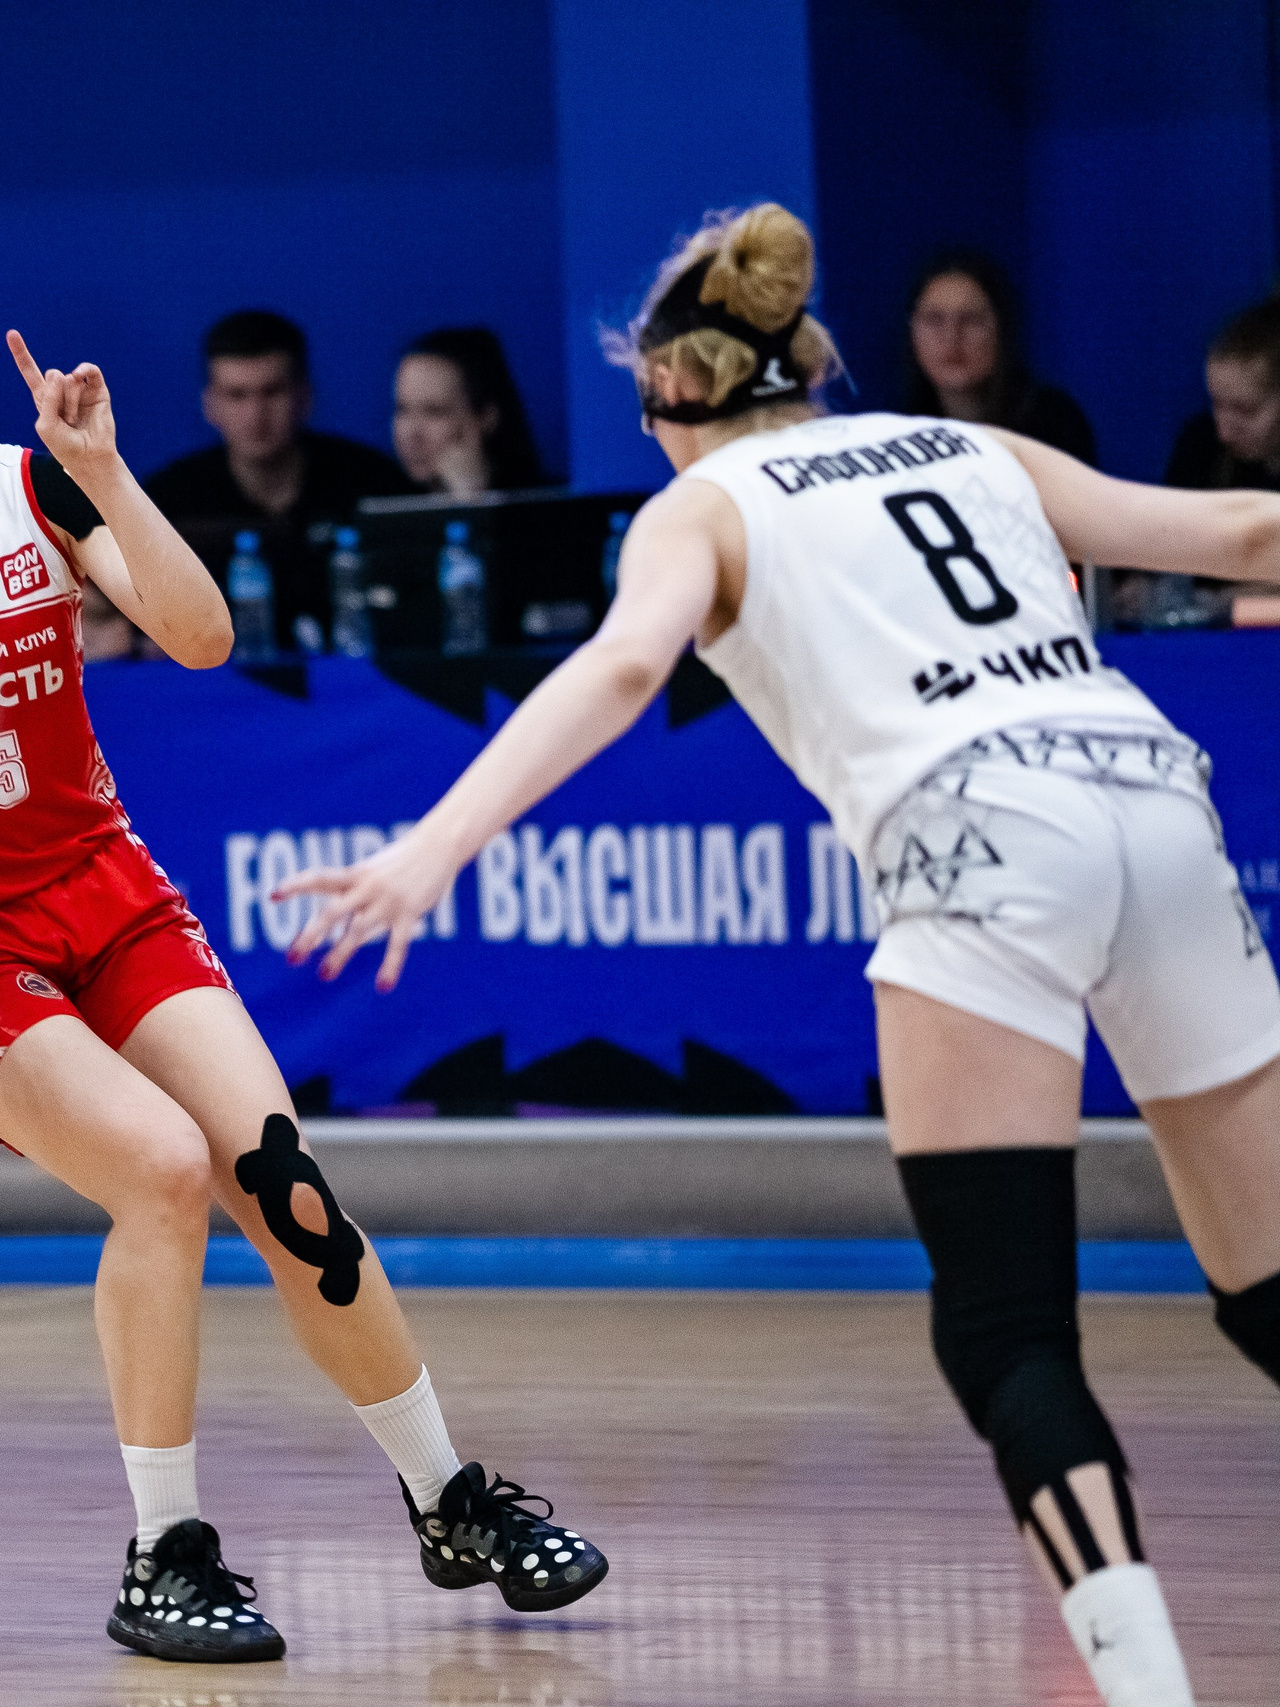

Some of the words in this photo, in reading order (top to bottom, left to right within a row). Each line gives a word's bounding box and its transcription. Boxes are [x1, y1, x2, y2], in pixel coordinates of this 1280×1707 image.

[3, 546, 38, 578] FON
[882, 490, 1019, 626] 8
[8, 564, 43, 595] BET
[14, 626, 57, 653] КЛУБ
[980, 636, 1091, 686] ЧКП
[477, 822, 788, 947] ВЫСШАЯ
